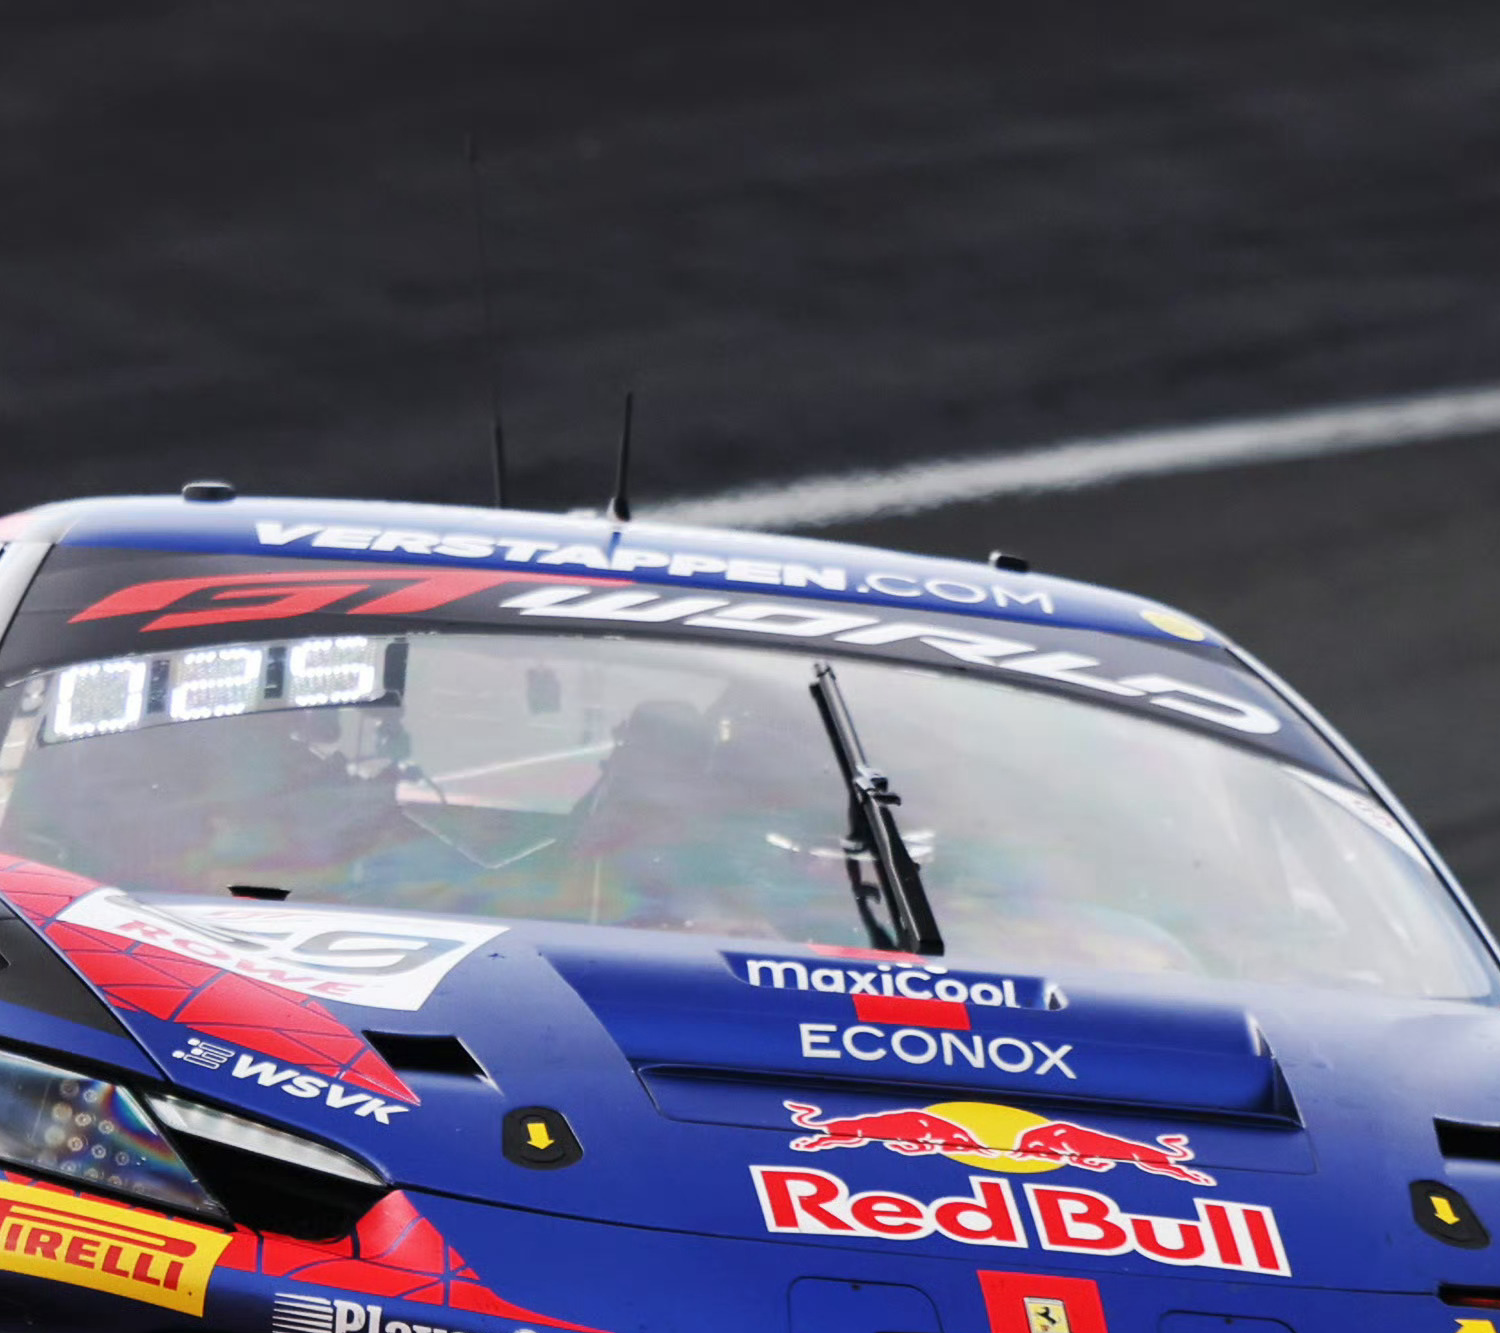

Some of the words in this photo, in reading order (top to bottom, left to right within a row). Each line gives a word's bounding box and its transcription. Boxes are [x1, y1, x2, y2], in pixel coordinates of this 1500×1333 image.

[255, 521, 1056, 616] VERSTAPPEN.COM
[67, 569, 634, 633] GT
[498, 584, 1283, 737] WORLD
[116, 920, 366, 998] ROWE
[746, 960, 1021, 1008] maxiCool
[231, 1054, 409, 1125] WSVK
[799, 1023, 1077, 1080] ECONOX
[755, 1167, 1023, 1245] Red
[1027, 1186, 1286, 1274] Bull
